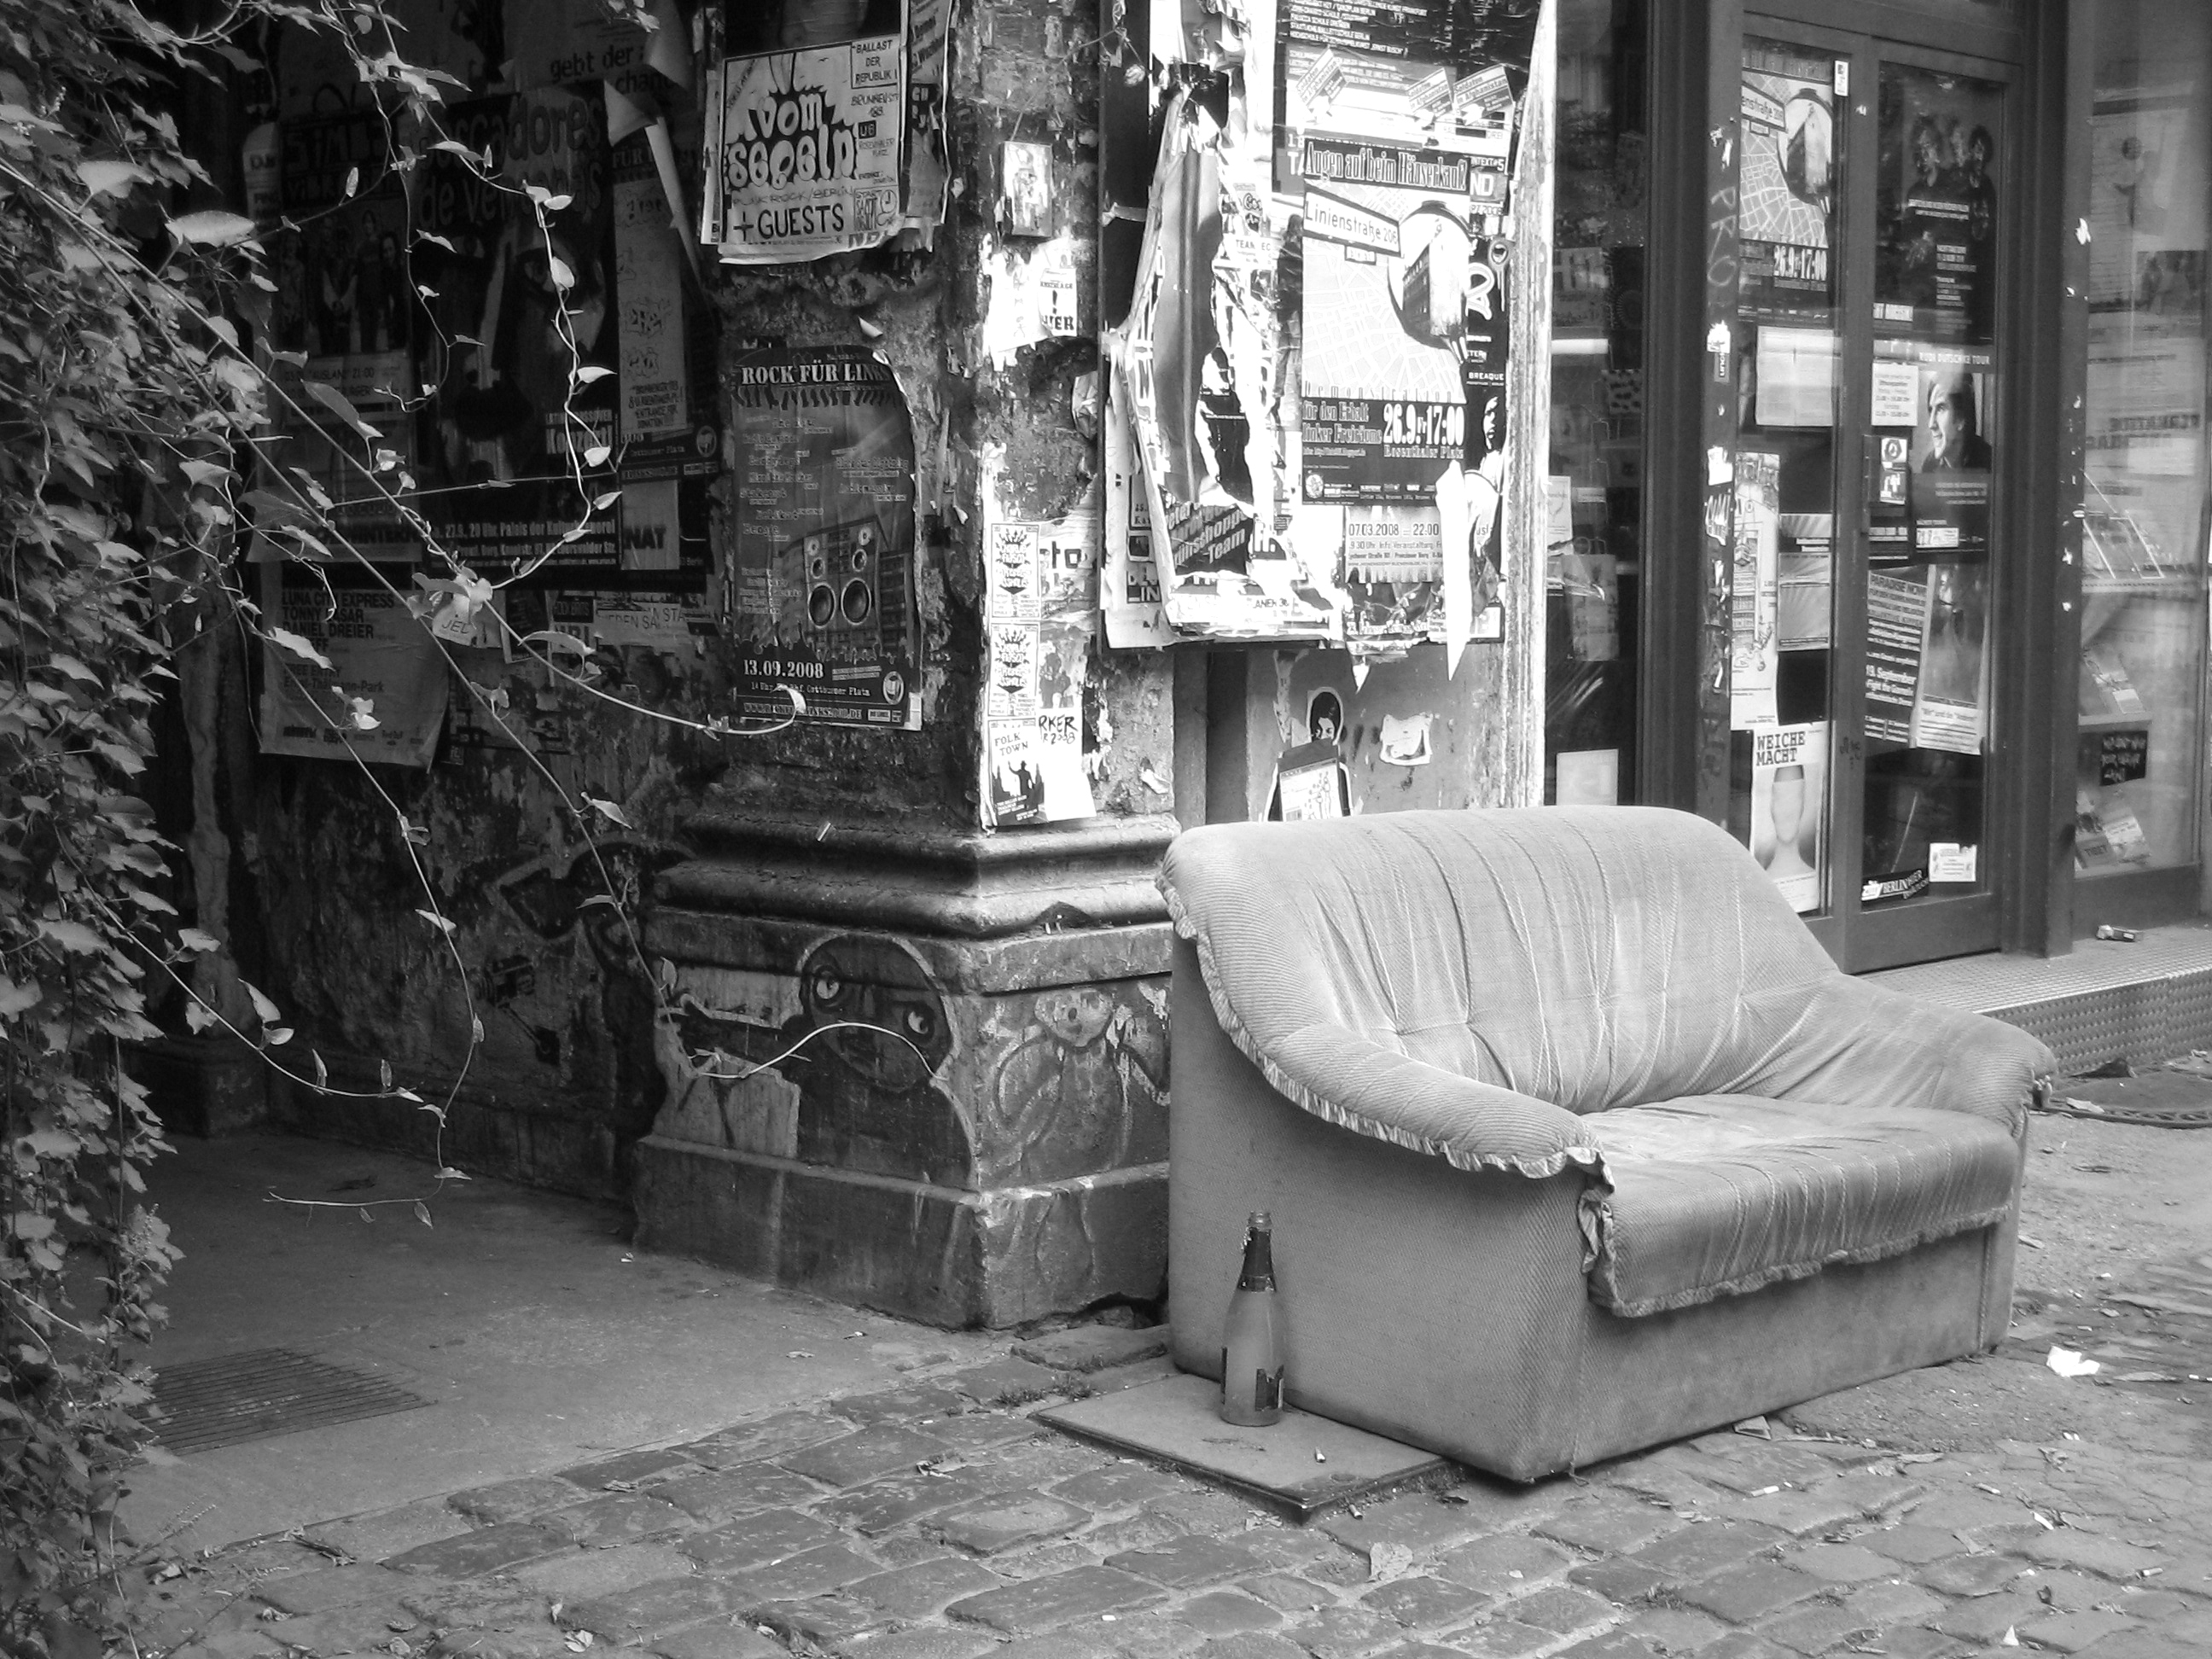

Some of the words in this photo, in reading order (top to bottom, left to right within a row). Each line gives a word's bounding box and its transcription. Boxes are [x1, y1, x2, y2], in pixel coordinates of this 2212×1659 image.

[602, 44, 634, 69] der
[855, 39, 893, 55] BALLAST
[865, 55, 881, 68] DER
[1305, 144, 1344, 183] Augen
[1346, 148, 1365, 181] auf
[1366, 148, 1396, 183] beim
[759, 203, 844, 240] GUESTS
[1305, 201, 1381, 243] Linienstraße
[742, 366, 795, 386] ROCK
[799, 358, 839, 383] FÜR
[1383, 403, 1420, 445] 26.9.
[1426, 405, 1464, 445] 17:00
[341, 592, 394, 608] EXPRESS
[282, 606, 322, 622] TONNY
[329, 623, 374, 639] DREIER
[743, 659, 824, 679] 13.09.2008
[994, 732, 1022, 747] FOLK
[999, 741, 1028, 756] TOWN
[1756, 731, 1805, 751] WEICHE
[1756, 748, 1797, 767] MACHT
